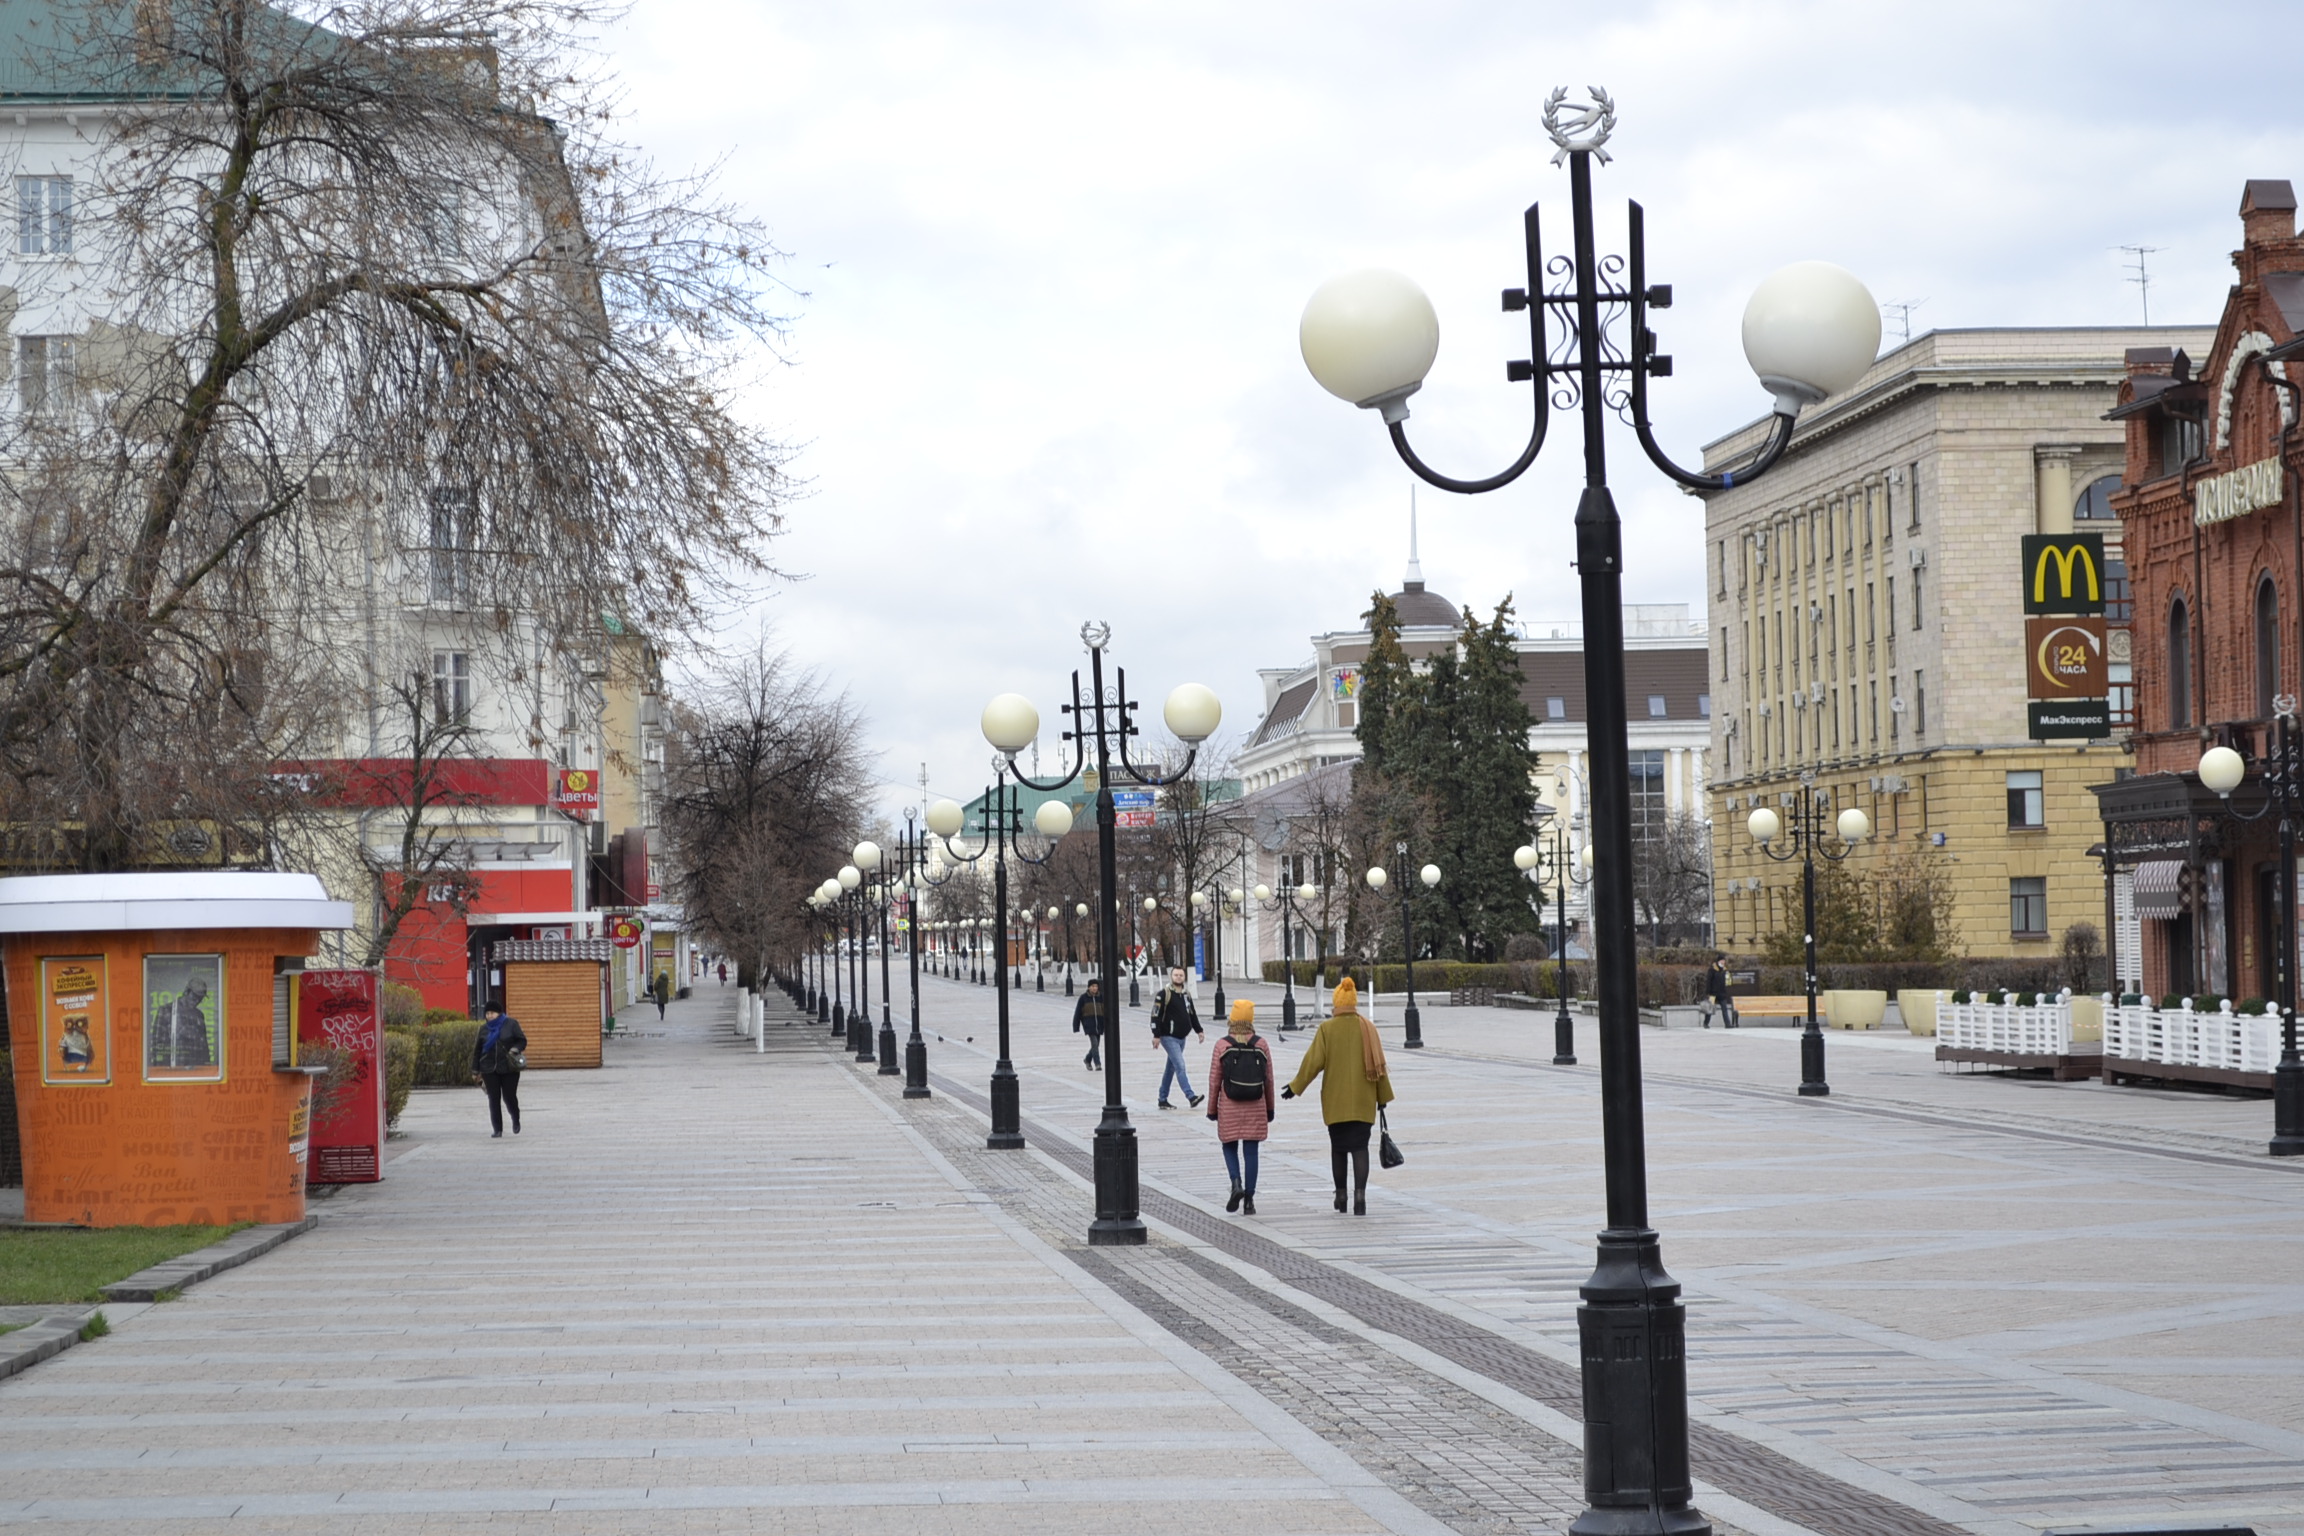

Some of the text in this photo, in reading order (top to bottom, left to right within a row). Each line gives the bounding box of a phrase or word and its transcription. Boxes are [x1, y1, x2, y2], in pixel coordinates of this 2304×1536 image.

[2034, 544, 2099, 602] M
[2059, 645, 2087, 666] 24
[2059, 665, 2087, 674] ЧАСА
[2040, 715, 2103, 726] МакЭкспресс
[1109, 769, 1156, 781] ПАСЖ
[56, 1101, 109, 1125] SHOP
[202, 1128, 266, 1144] COFFEE
[122, 1142, 195, 1157] HOUSE
[203, 1145, 266, 1160] TIME
[132, 1162, 177, 1178] Bon
[119, 1178, 198, 1198] appetit
